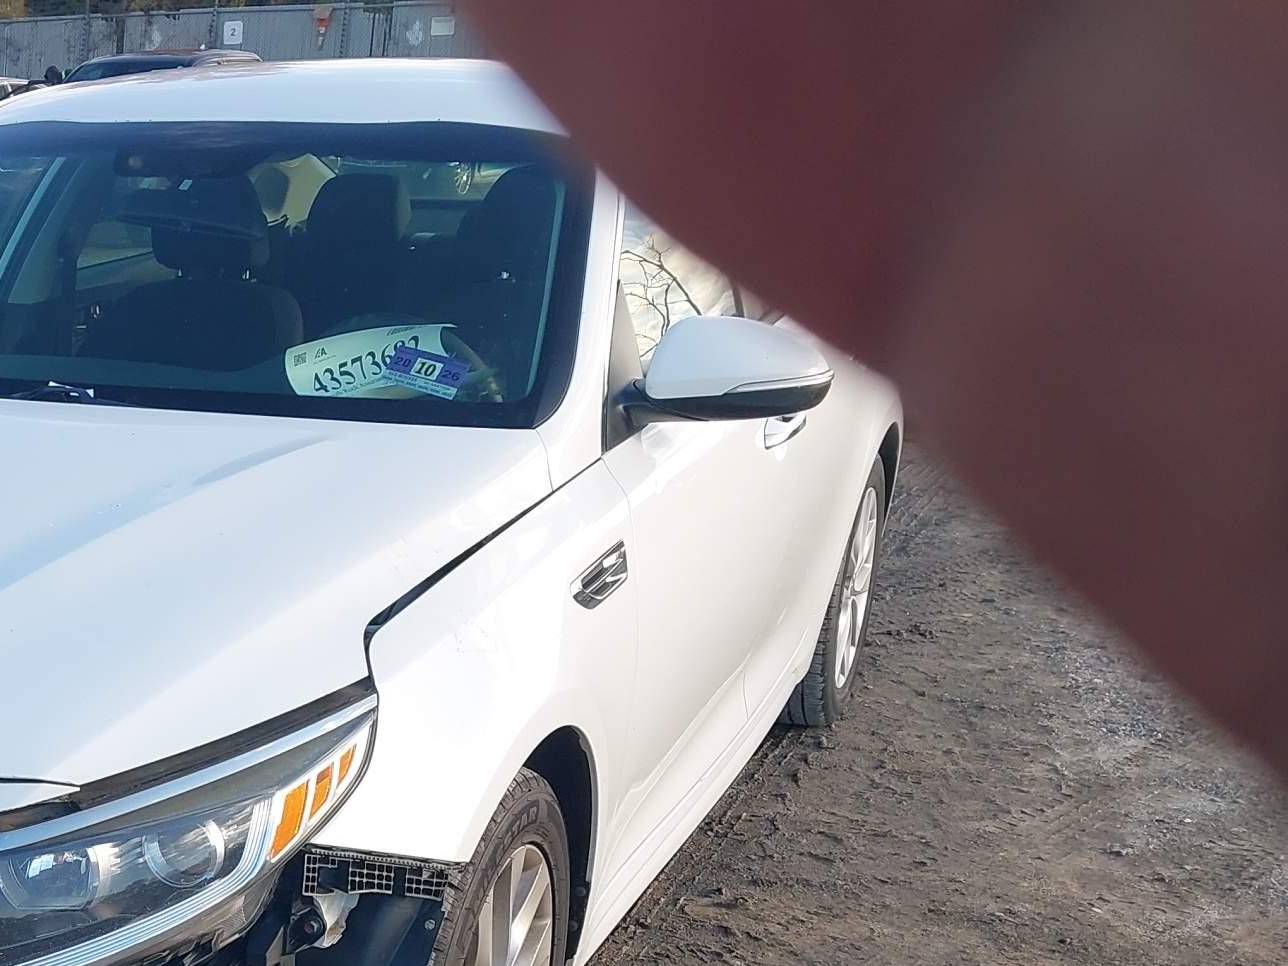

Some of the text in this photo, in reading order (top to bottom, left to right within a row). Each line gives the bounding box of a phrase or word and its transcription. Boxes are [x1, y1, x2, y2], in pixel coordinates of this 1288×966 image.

[393, 356, 460, 382] 20 10 26
